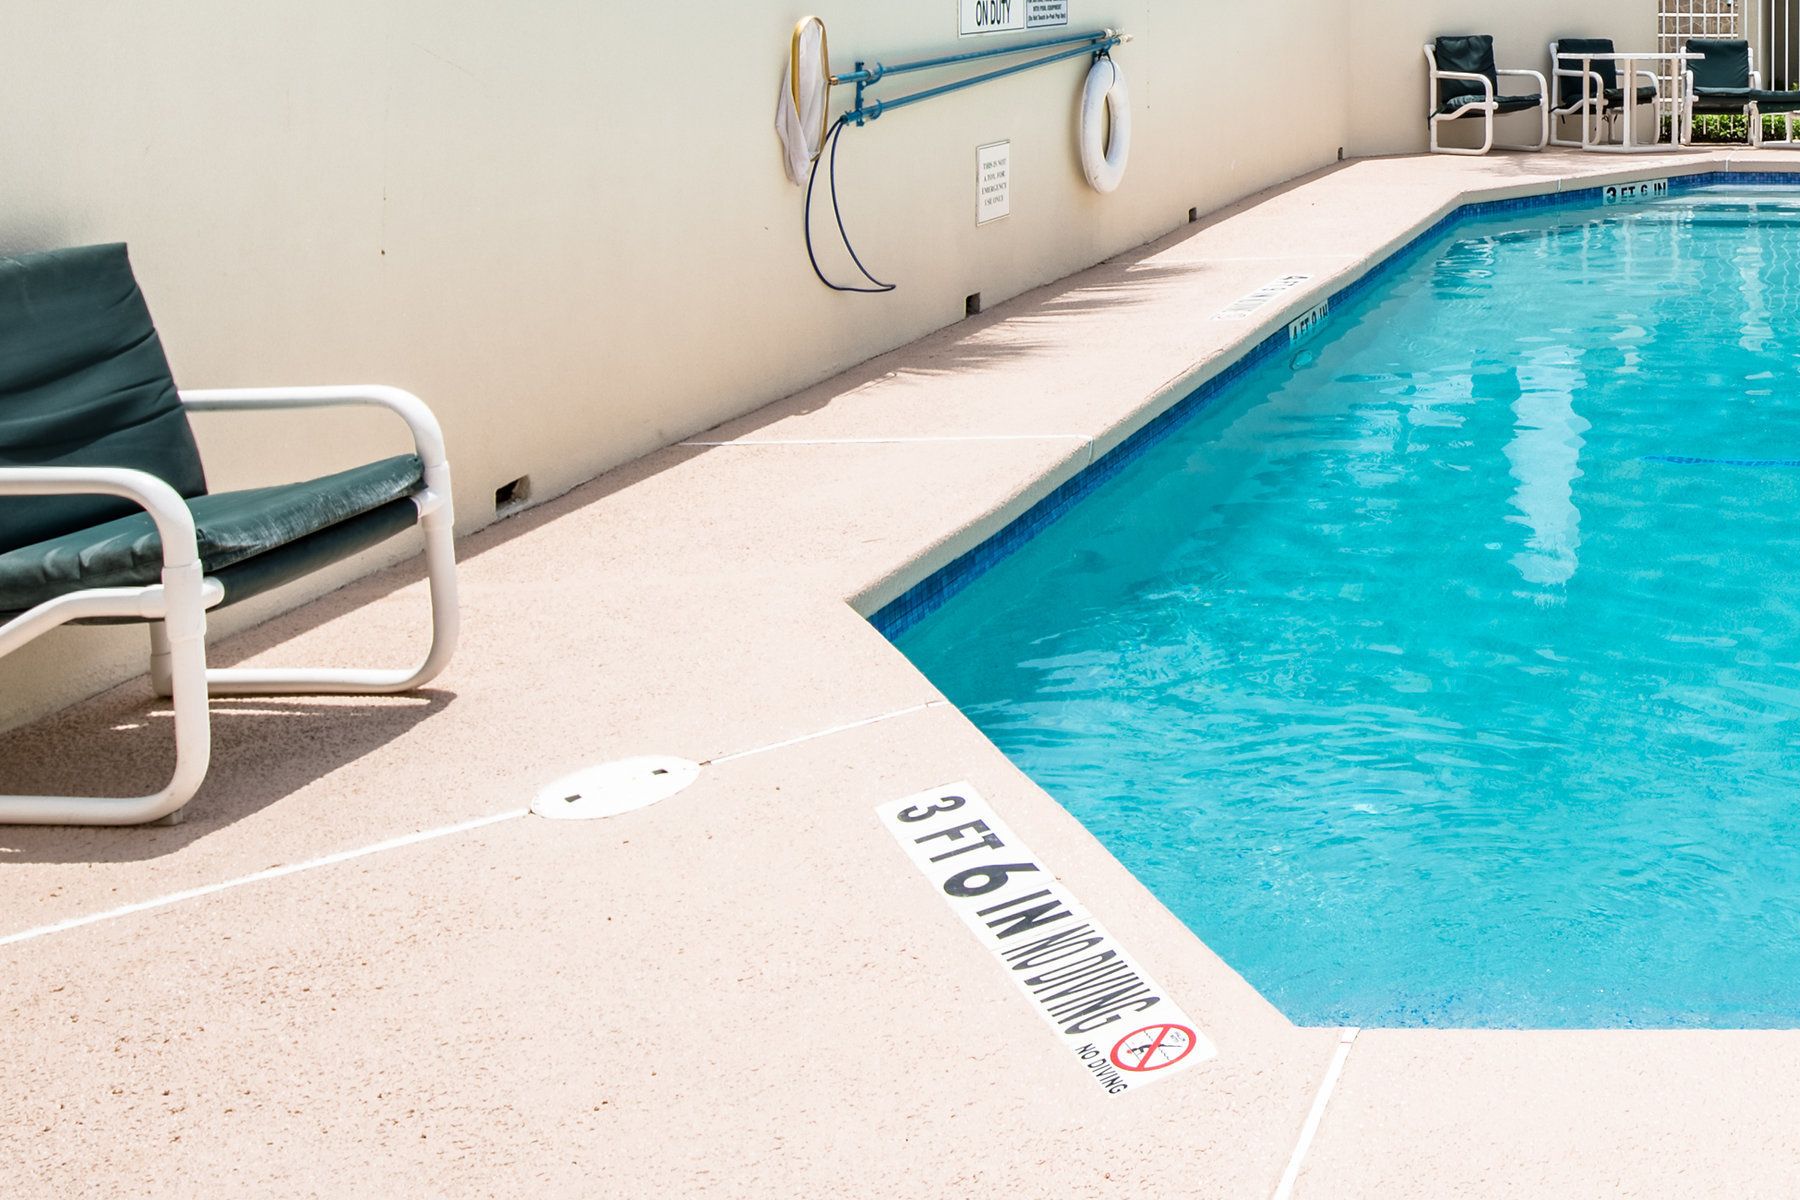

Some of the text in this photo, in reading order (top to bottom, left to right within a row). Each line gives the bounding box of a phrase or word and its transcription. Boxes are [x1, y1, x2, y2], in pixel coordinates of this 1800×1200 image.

[975, 0, 1011, 26] ON DUTY
[981, 182, 1006, 195] EMERGENCY
[1606, 187, 1617, 203] 3
[1653, 182, 1666, 195] IN
[897, 795, 1073, 940] 3 FT 6 IN
[1001, 923, 1160, 1035] NO DIVING
[1075, 1043, 1128, 1094] NO DIVING
